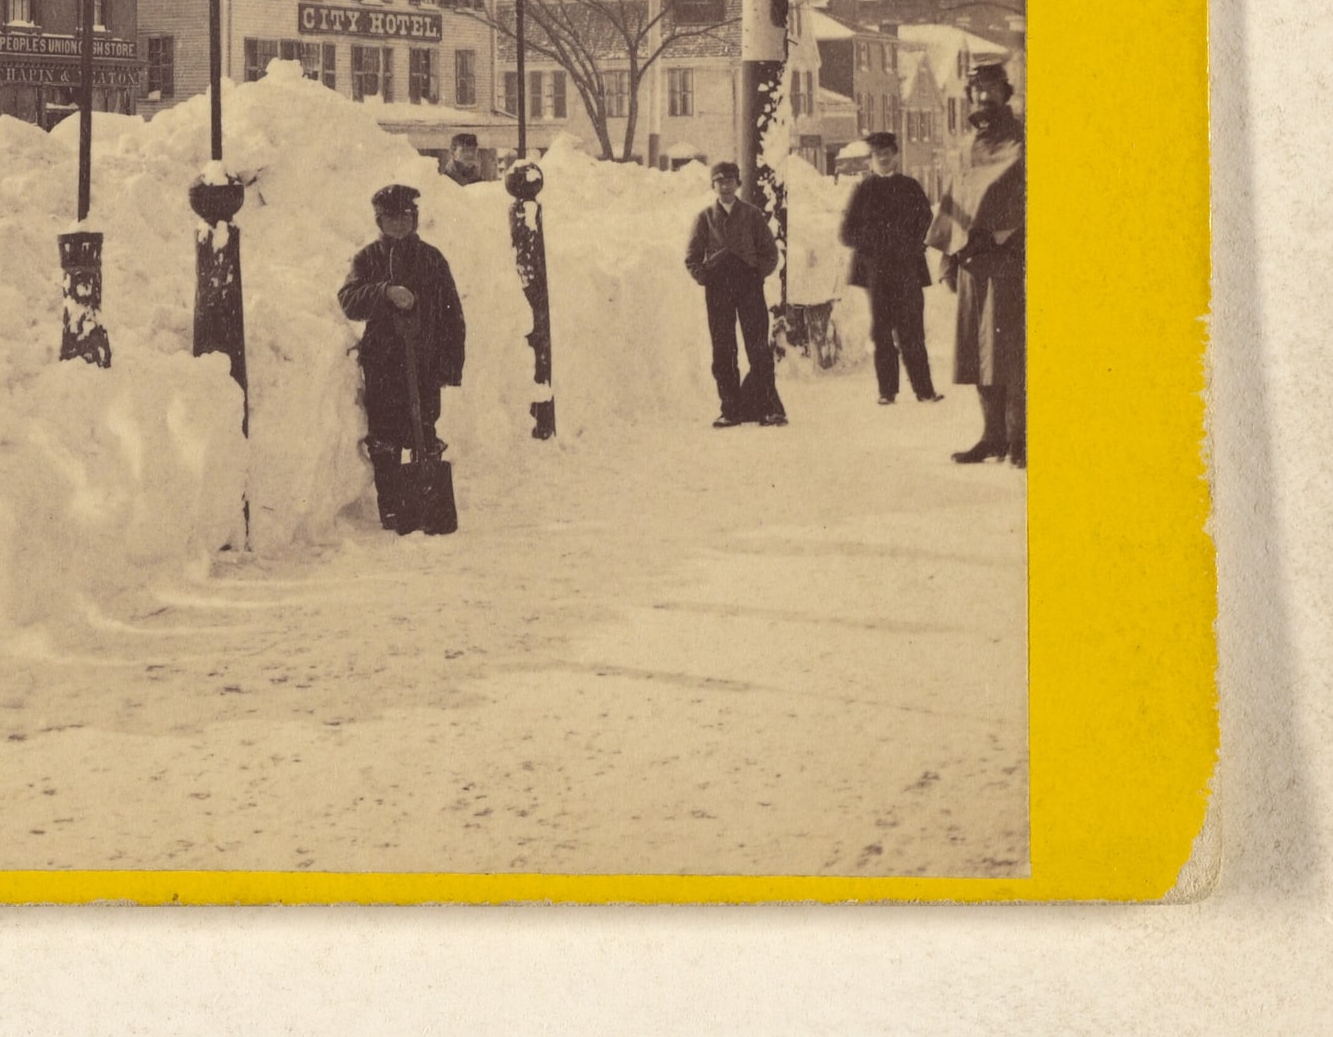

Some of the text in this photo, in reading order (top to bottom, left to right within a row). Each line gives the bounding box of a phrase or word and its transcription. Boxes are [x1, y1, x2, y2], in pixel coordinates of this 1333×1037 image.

[302, 7, 361, 32] CITY
[48, 39, 78, 55] UNION
[104, 42, 135, 57] STORE
[60, 70, 71, 83] &
